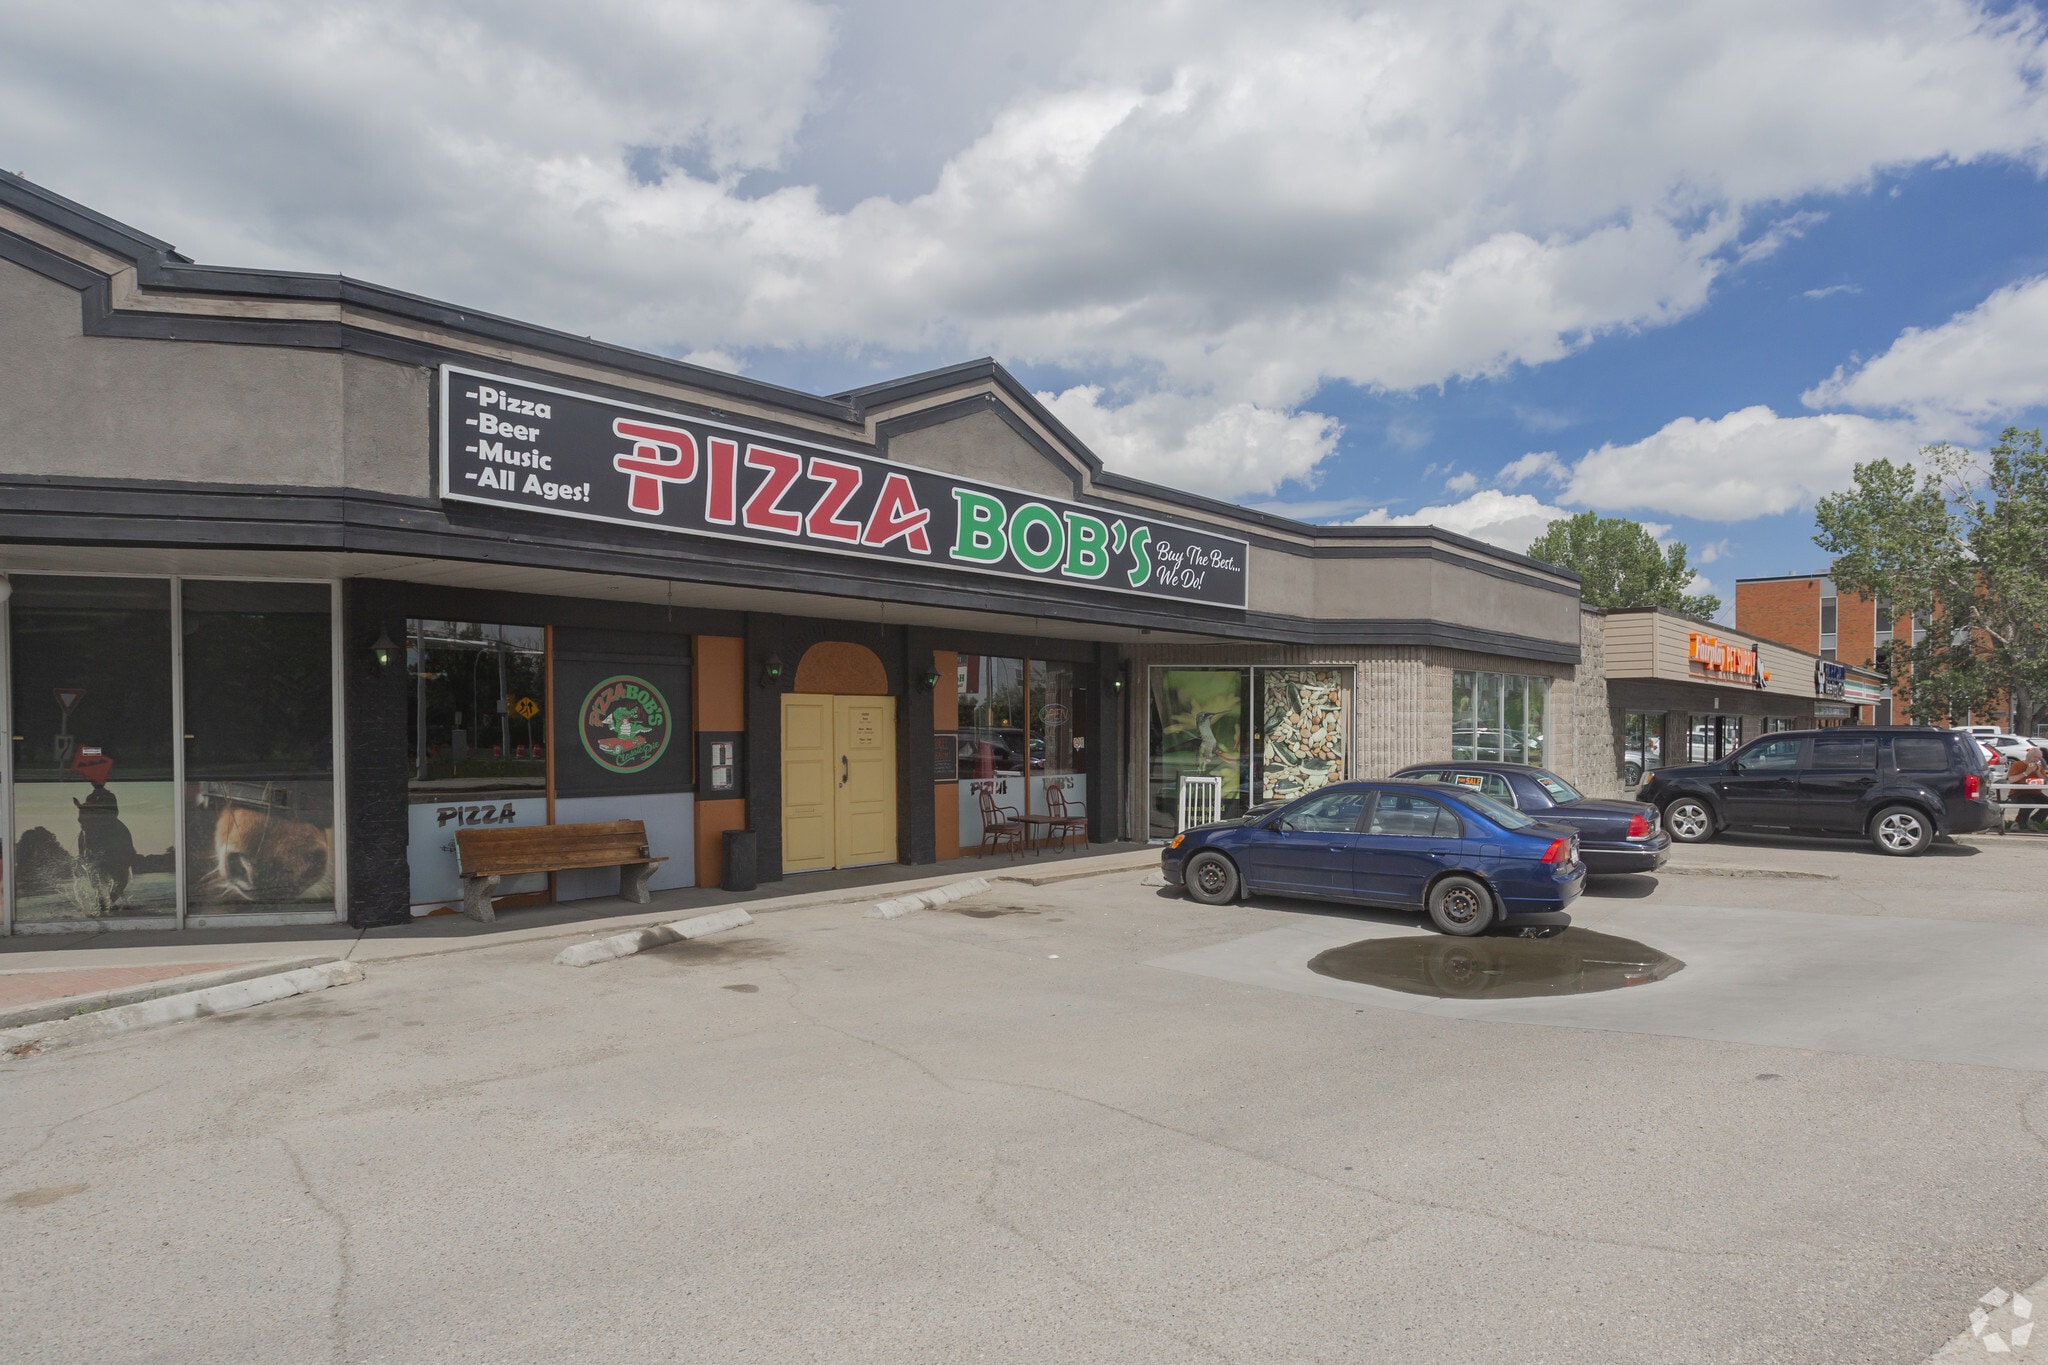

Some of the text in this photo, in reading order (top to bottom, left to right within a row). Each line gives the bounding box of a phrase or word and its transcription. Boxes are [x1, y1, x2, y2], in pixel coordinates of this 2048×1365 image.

[465, 385, 551, 419] -Pizza
[465, 412, 540, 442] -Beer
[465, 439, 552, 470] -Music
[465, 466, 590, 502] -All Ages!
[612, 417, 1152, 588] PIZZA BOB'S
[1156, 541, 1241, 572] Buy The Best...
[1156, 565, 1206, 590] We Do!
[589, 683, 663, 728] PIZZA BOB'S
[616, 741, 660, 766] Classic Pie
[1465, 777, 1481, 786] SALE
[436, 802, 516, 828] PIZZA
